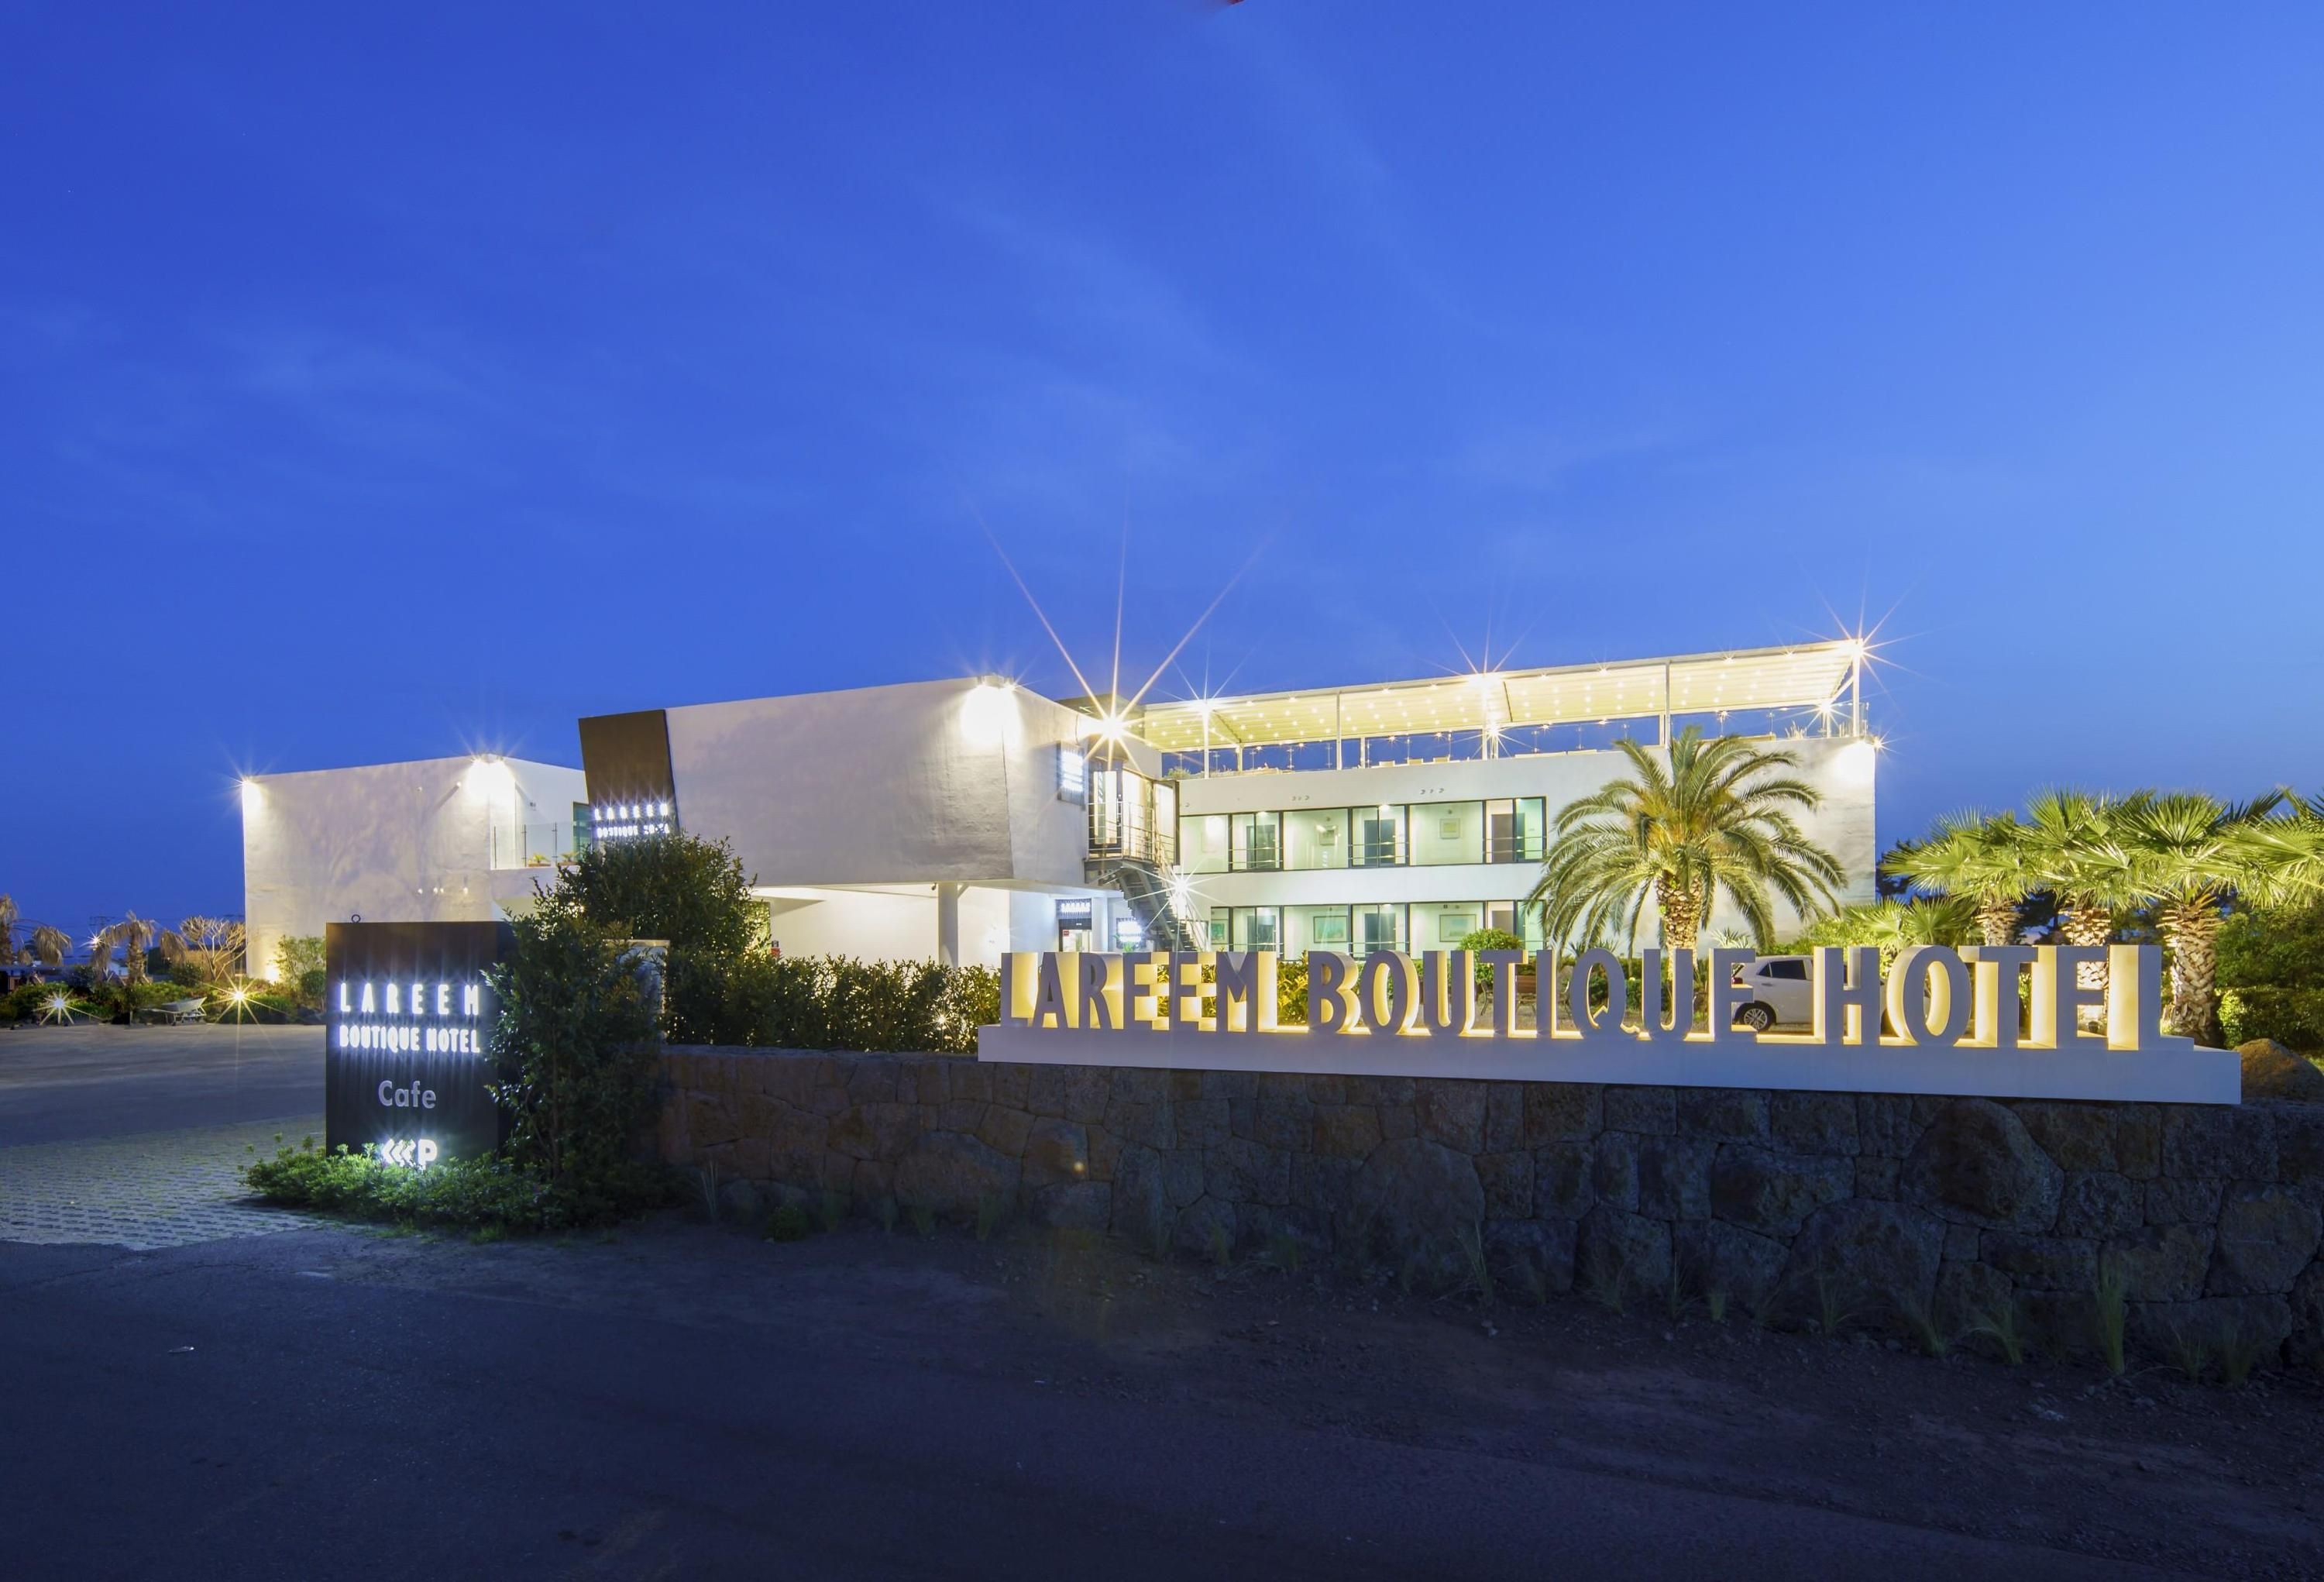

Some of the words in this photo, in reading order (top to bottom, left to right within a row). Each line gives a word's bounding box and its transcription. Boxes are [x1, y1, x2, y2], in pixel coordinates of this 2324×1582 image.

[340, 982, 479, 1016] LAREEM
[1001, 951, 1278, 1032] LAREEM
[1308, 949, 1758, 1043] BOUTIQUE
[1814, 944, 2195, 1051] HOTEL
[339, 1024, 420, 1053] BOUTIQUE
[426, 1028, 480, 1053] HOTEL
[378, 1080, 436, 1109] Cafe
